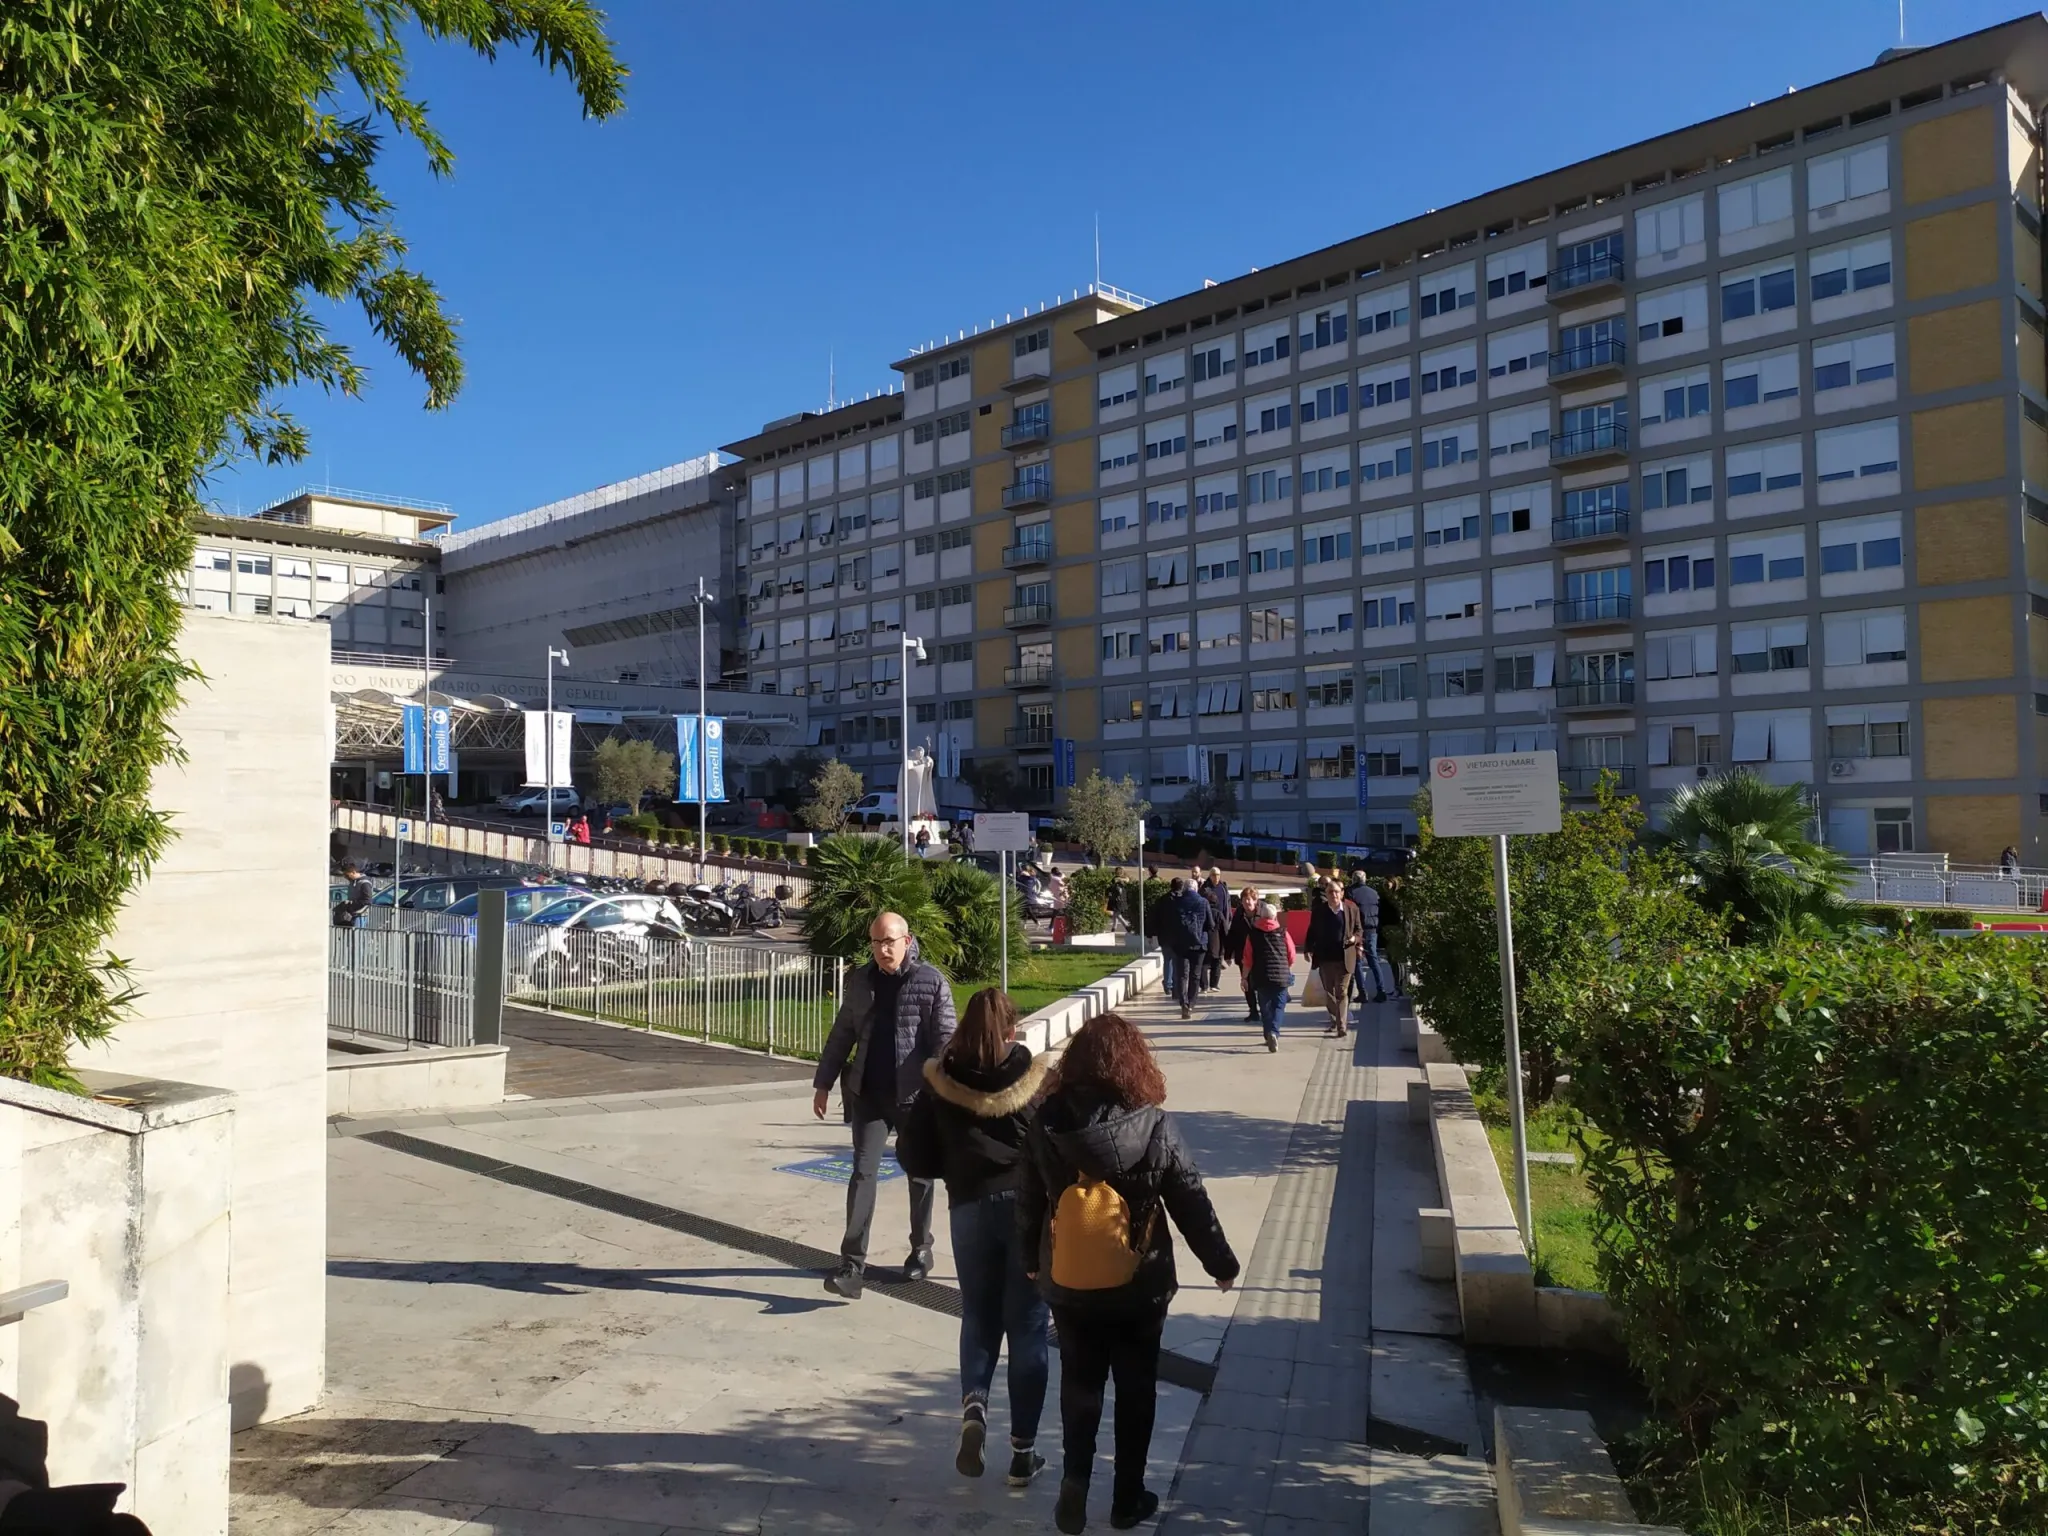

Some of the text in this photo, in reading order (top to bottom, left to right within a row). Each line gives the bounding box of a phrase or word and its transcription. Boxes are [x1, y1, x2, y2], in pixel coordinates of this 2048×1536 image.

[565, 688, 618, 701] GEMELLI
[434, 730, 446, 772] Gemelli
[1466, 758, 1537, 769] VIETATO FUMARE
[709, 746, 722, 799] Gemelli
[554, 825, 561, 833] P
